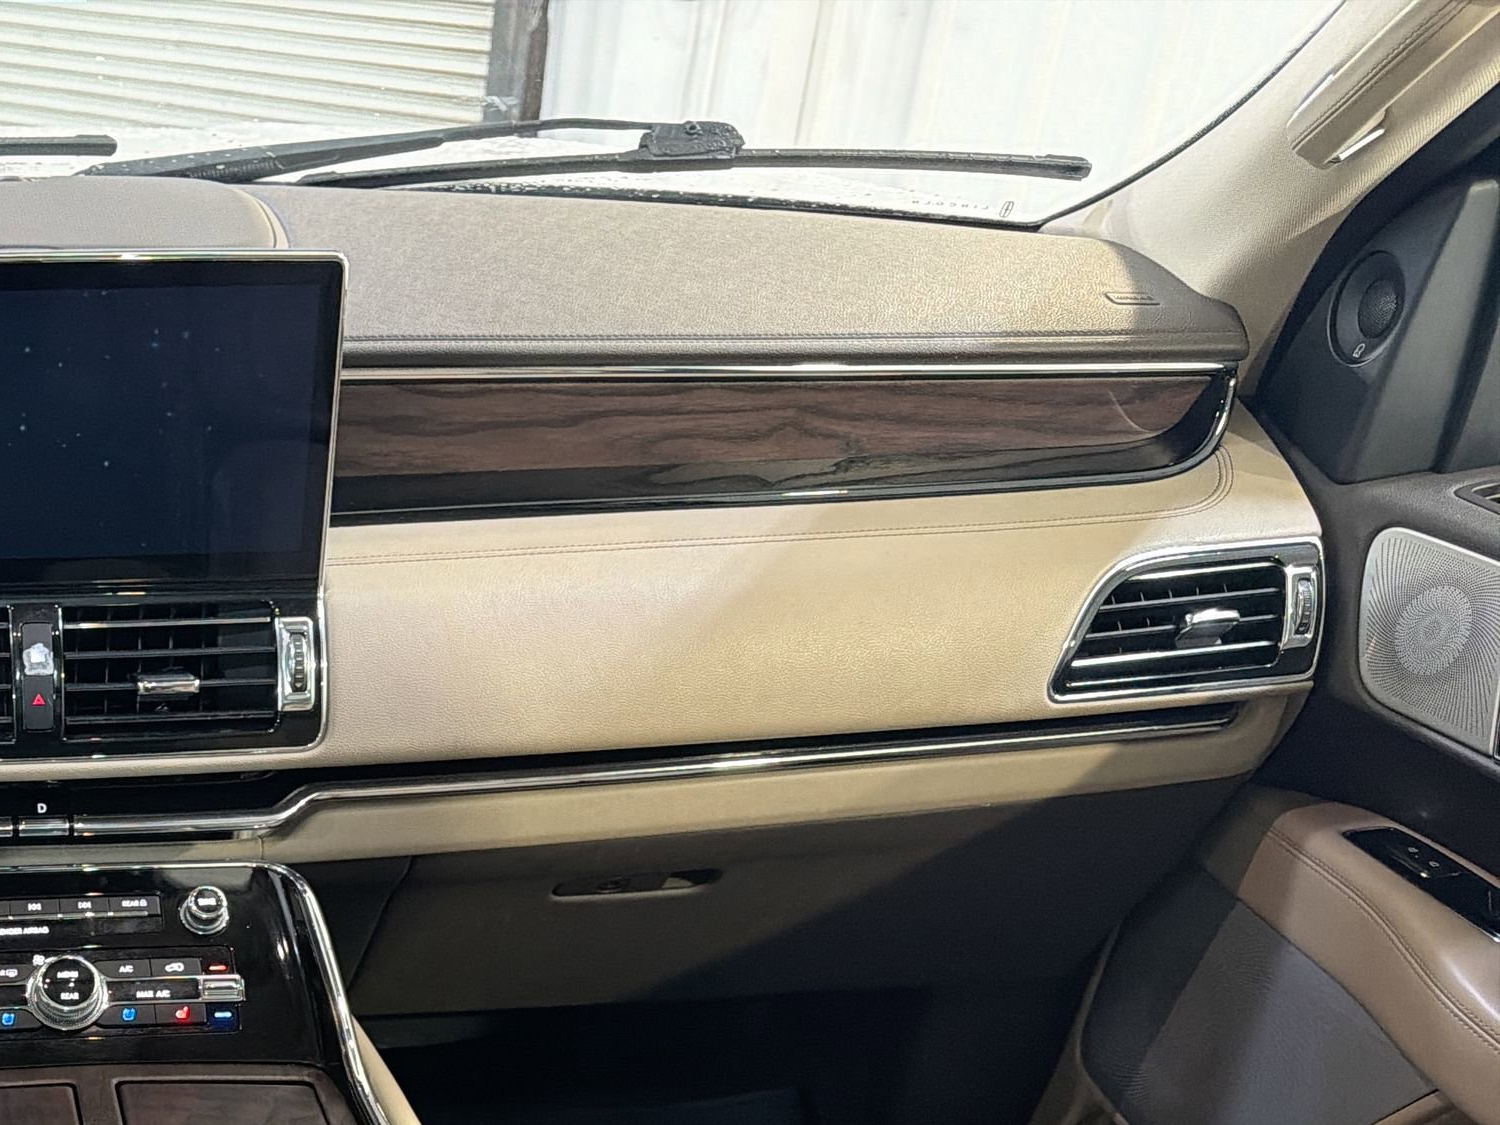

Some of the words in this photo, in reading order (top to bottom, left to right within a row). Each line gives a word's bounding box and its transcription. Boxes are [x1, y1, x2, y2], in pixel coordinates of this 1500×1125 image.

[37, 803, 47, 814] D
[119, 965, 134, 973] A/C
[60, 992, 79, 1000] REAR
[156, 989, 171, 998] A/C
